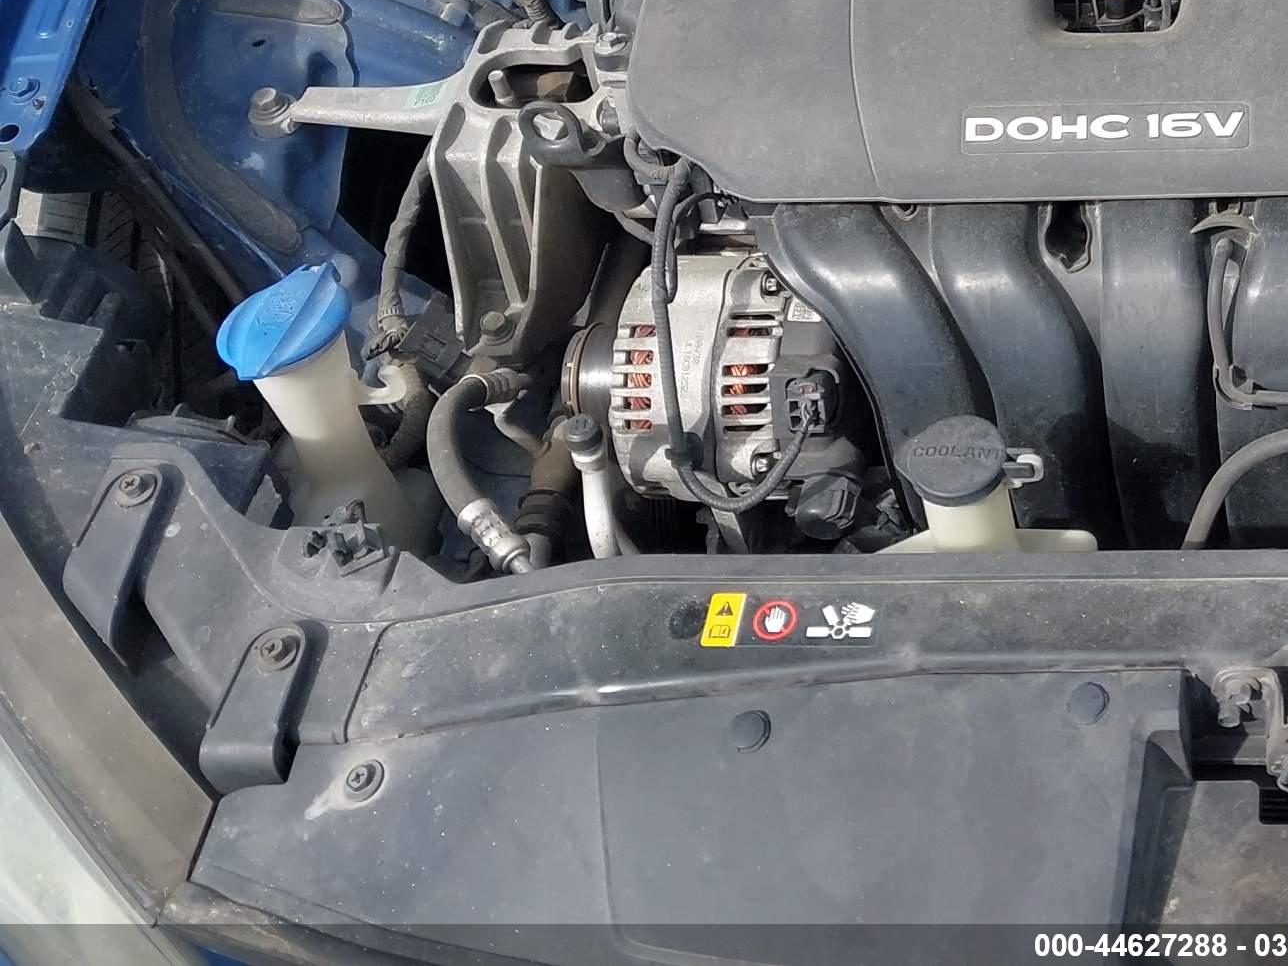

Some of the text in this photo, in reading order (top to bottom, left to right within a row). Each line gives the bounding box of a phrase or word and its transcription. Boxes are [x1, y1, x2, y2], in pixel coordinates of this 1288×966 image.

[965, 111, 1244, 142] DOHC 16V
[913, 445, 1005, 461] COOLANT
